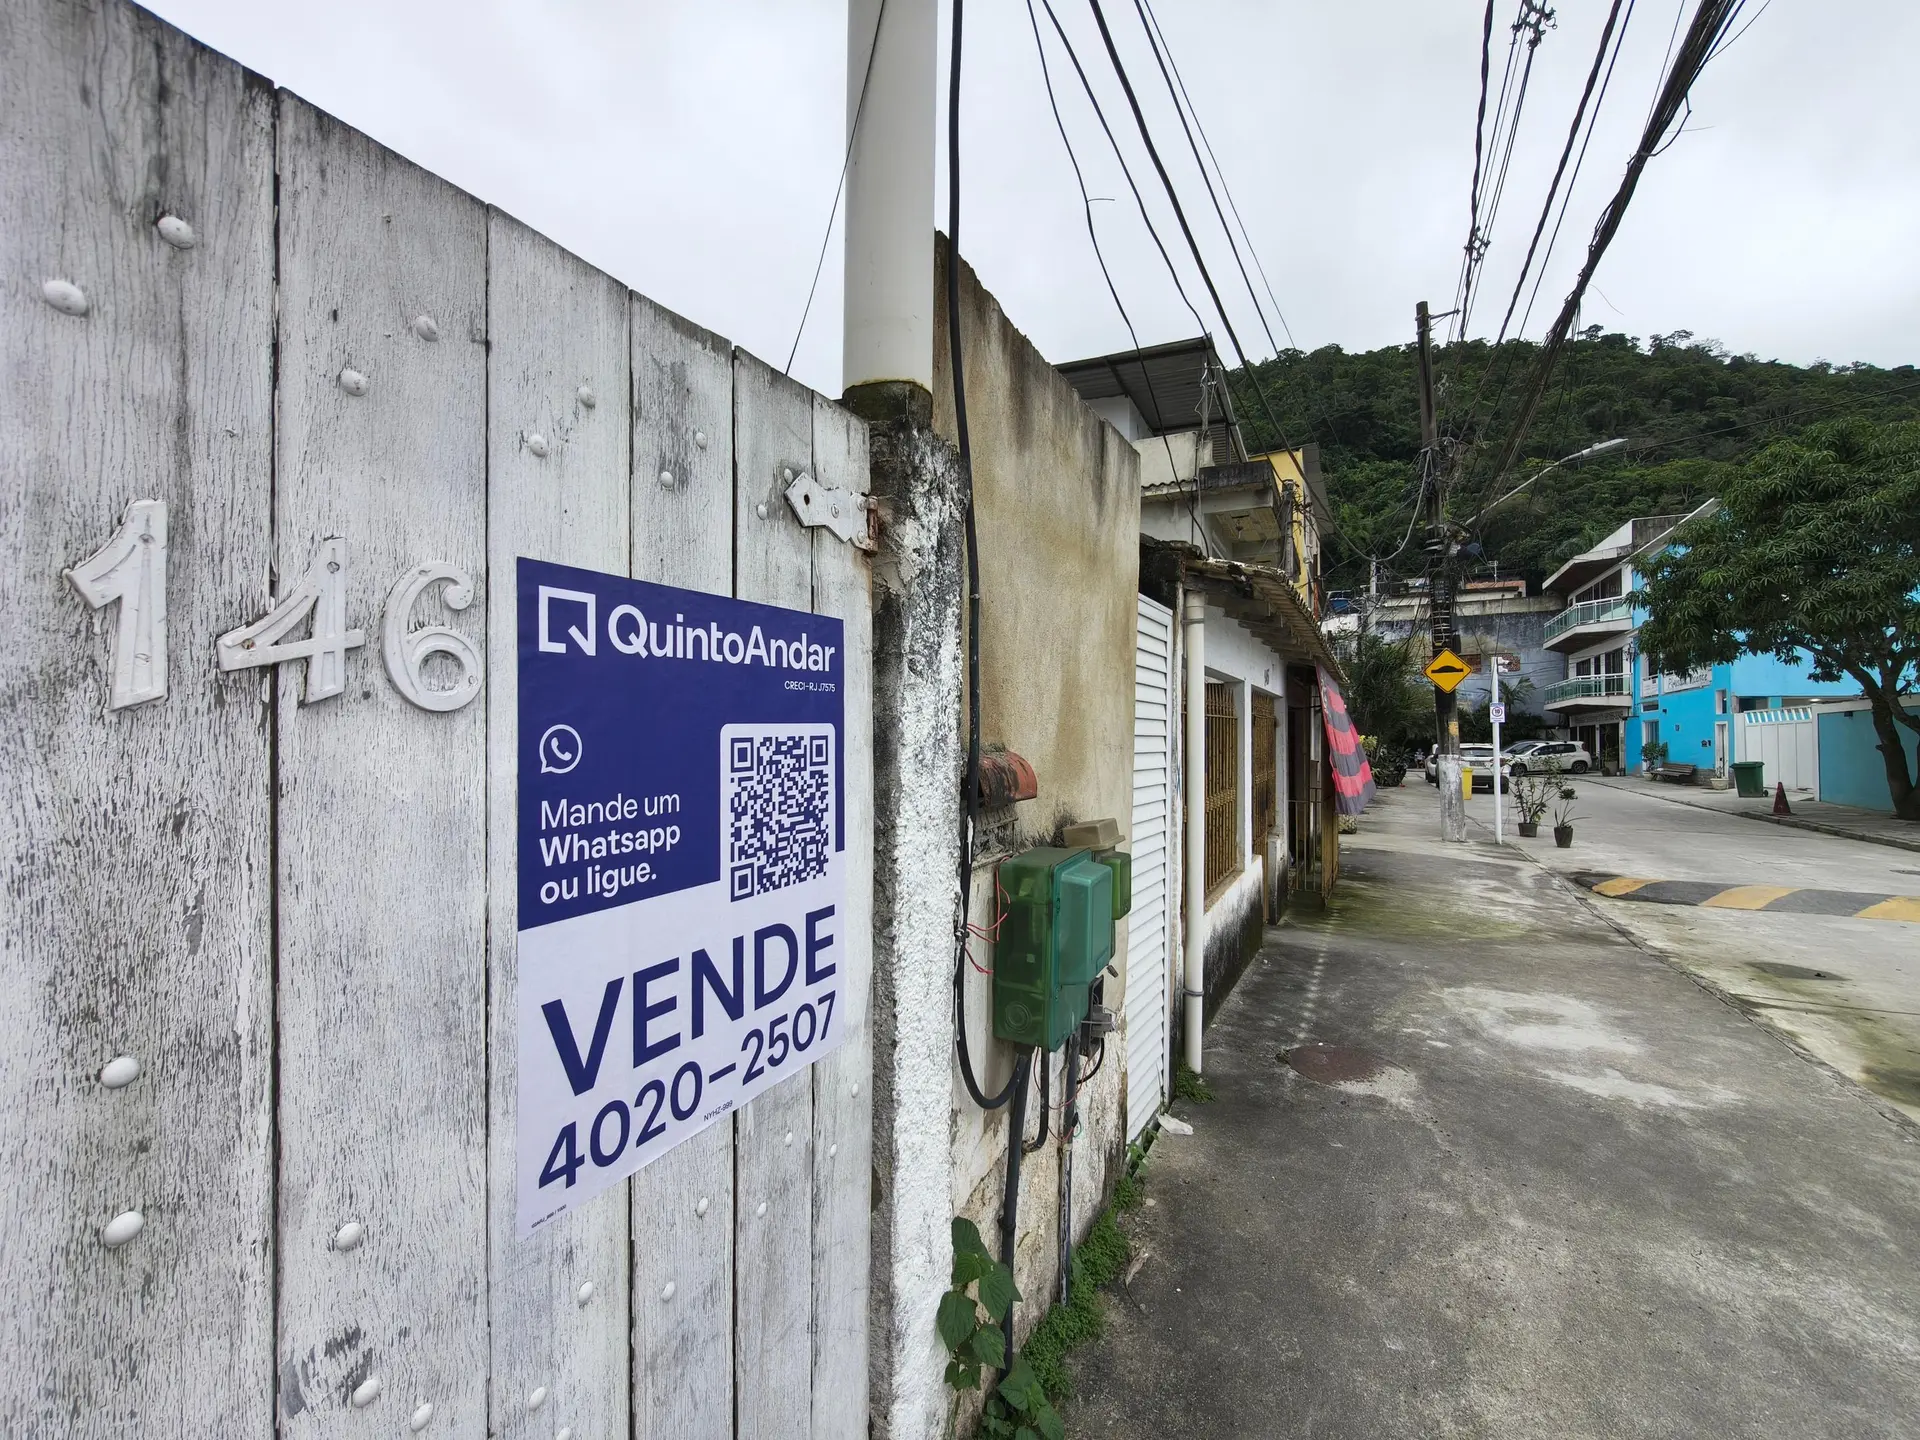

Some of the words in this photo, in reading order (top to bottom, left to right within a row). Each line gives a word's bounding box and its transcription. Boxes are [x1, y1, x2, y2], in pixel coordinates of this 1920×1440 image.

[63, 499, 484, 713] 146
[608, 604, 836, 672] QuintoAndar
[784, 680, 818, 692] CRECI-RJ
[541, 792, 638, 830] Mande
[644, 794, 680, 817] um
[540, 825, 681, 867] Whatsapp
[540, 876, 579, 905] ou
[587, 863, 657, 898] ligue.
[541, 903, 836, 1097] VENDE
[538, 990, 836, 1190] 4020-2507
